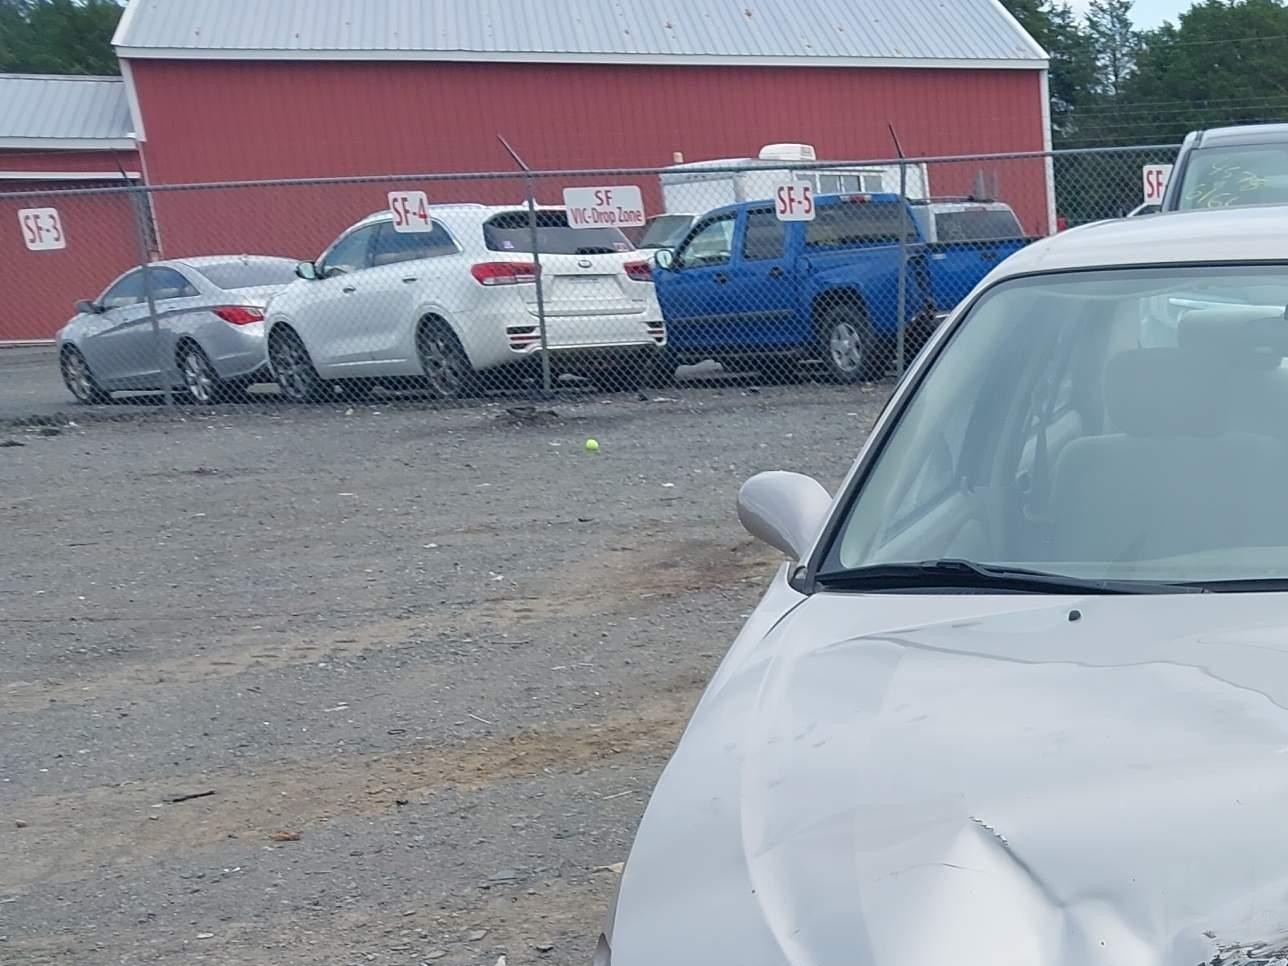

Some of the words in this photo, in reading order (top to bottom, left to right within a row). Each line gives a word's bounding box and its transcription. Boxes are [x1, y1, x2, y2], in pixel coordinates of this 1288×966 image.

[594, 189, 613, 207] SF
[1146, 169, 1168, 199] SF
[392, 197, 429, 226] SF-4
[777, 186, 812, 215] SF-5
[23, 213, 62, 244] SF-3
[570, 206, 616, 225] VIC-Drop
[616, 206, 643, 223] Zone
